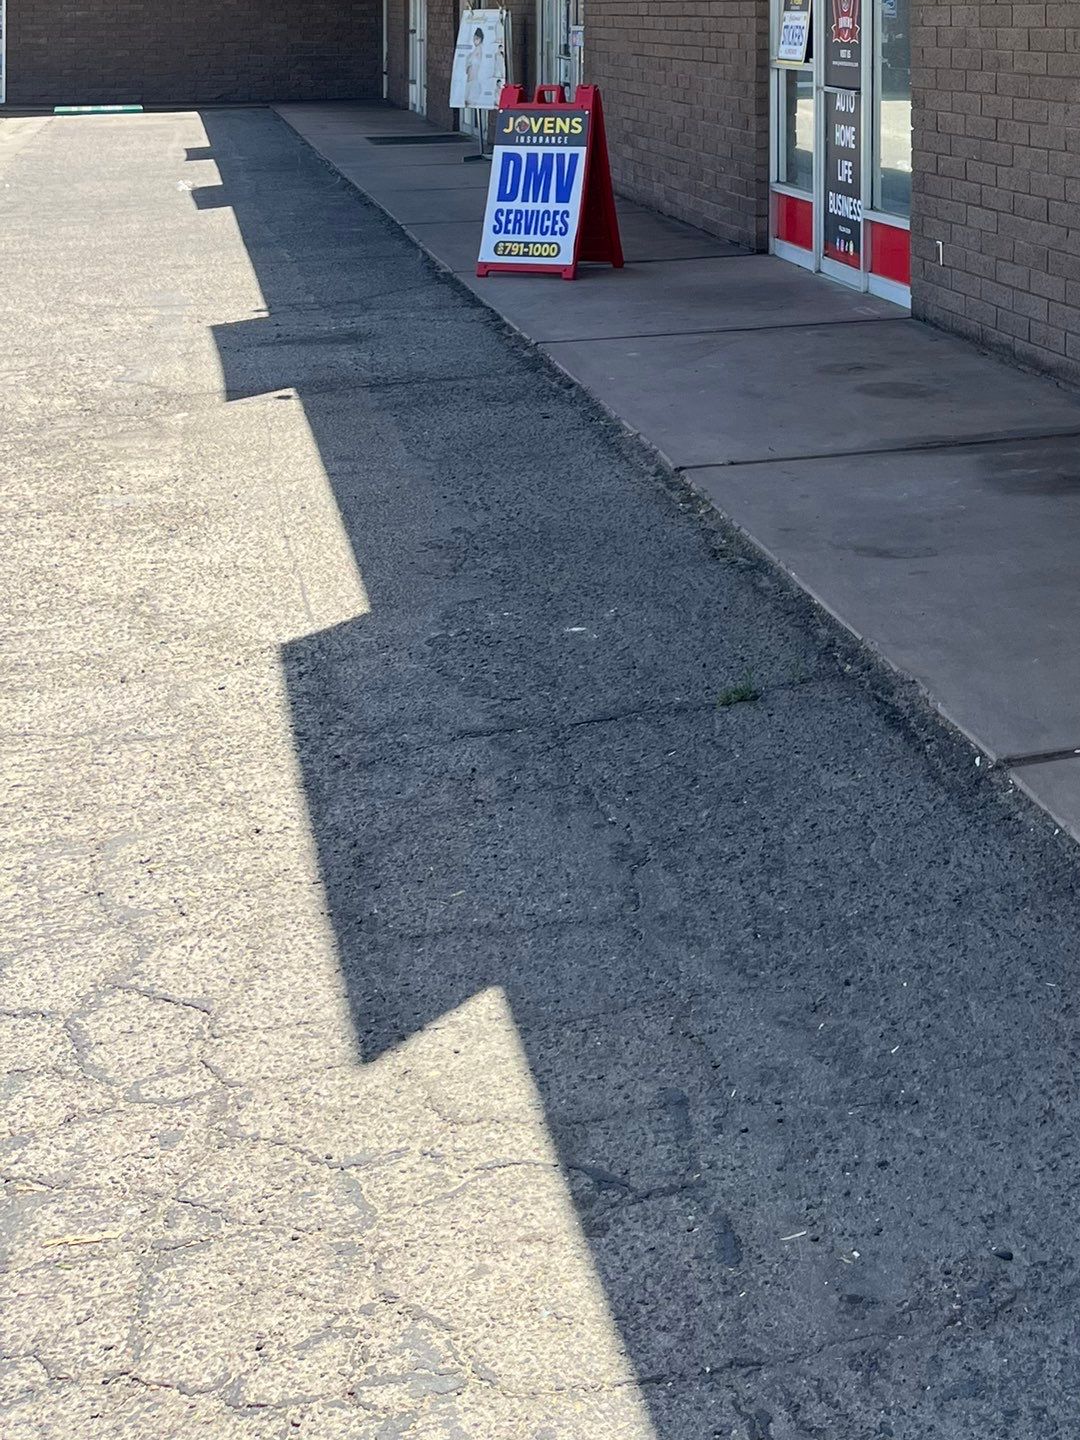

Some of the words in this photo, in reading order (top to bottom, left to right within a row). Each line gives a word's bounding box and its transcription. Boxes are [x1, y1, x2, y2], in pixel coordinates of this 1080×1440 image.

[835, 92, 855, 114] AUTO
[502, 114, 583, 135] JOVENS
[835, 123, 856, 149] HOME
[496, 151, 580, 204] DMV
[837, 158, 853, 184] LIFE
[828, 190, 862, 222] BUSINESS
[492, 208, 570, 237] SERVICES
